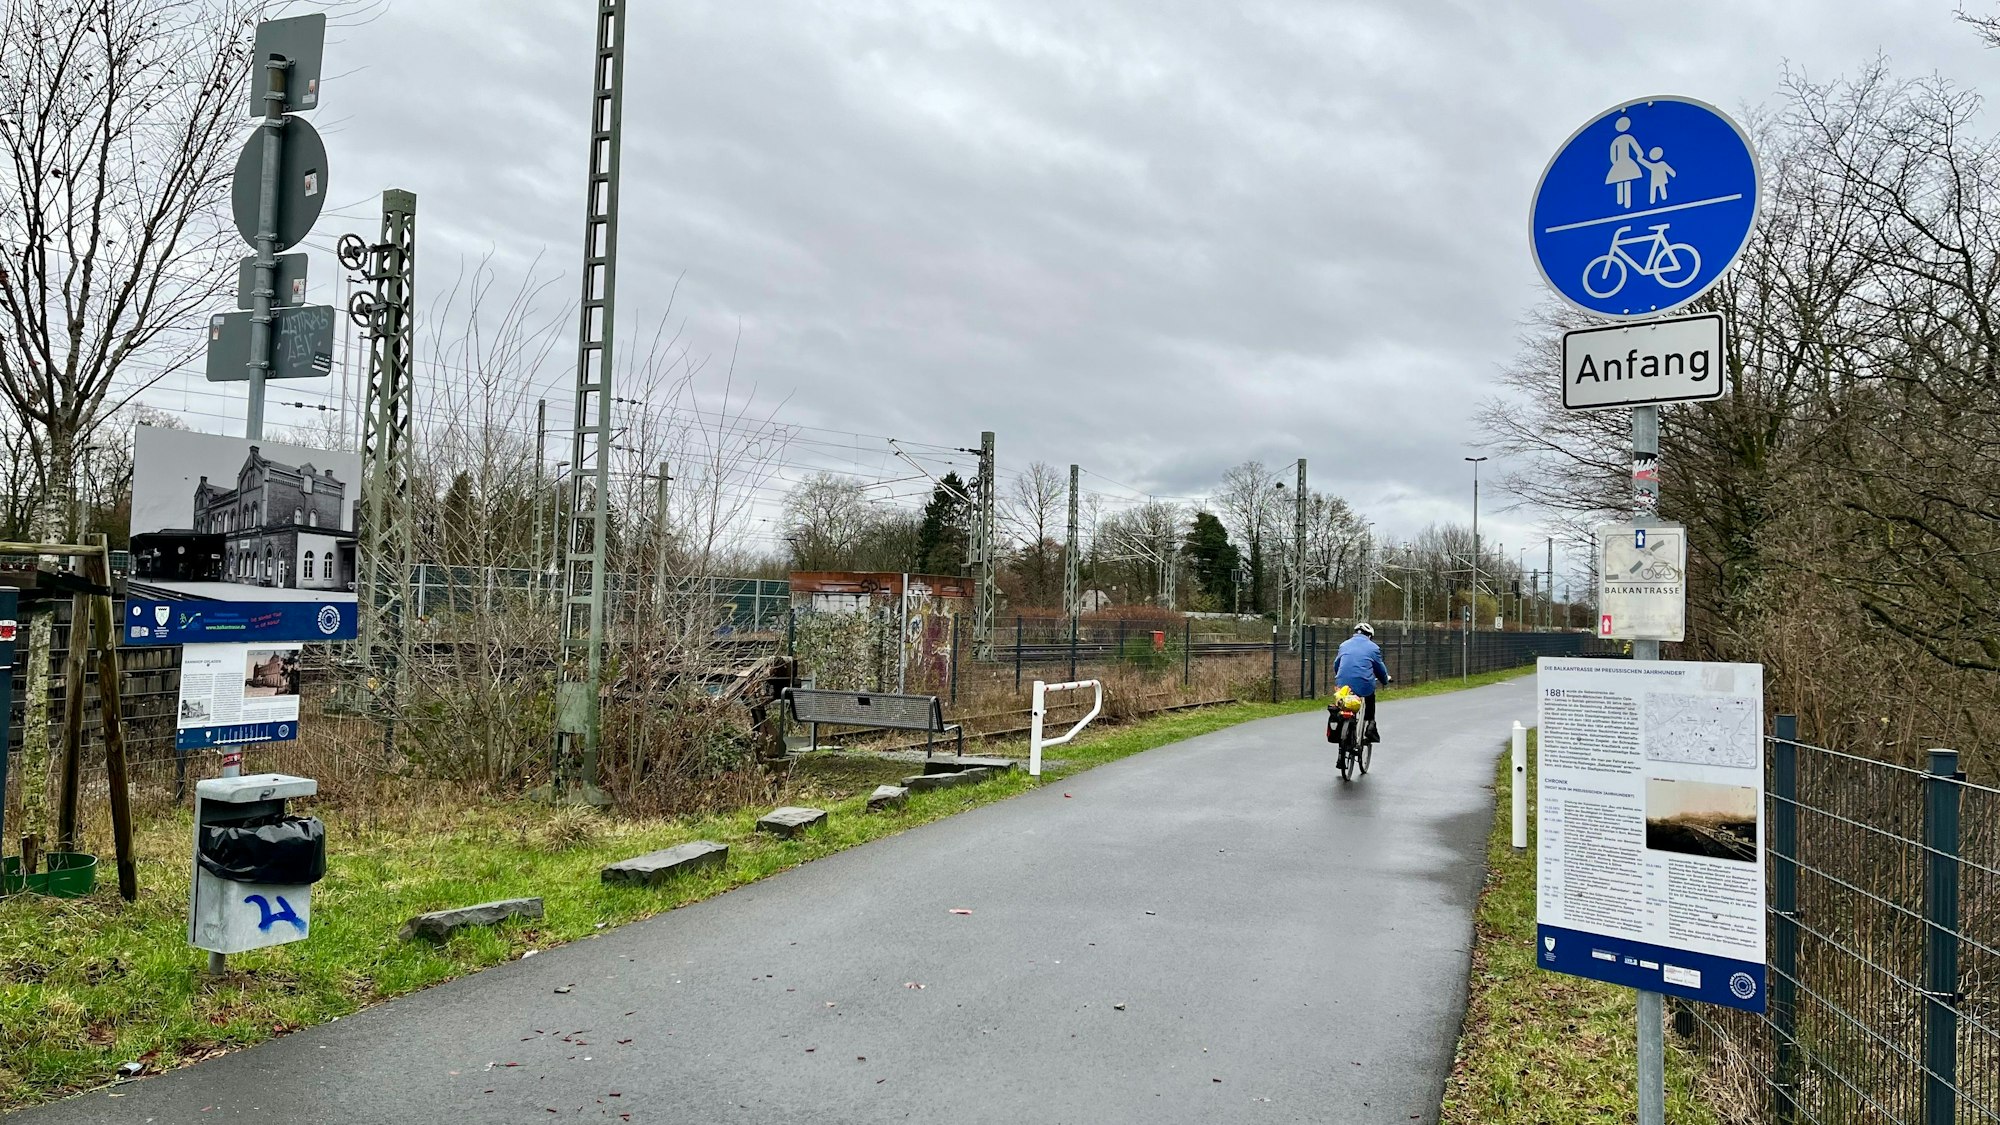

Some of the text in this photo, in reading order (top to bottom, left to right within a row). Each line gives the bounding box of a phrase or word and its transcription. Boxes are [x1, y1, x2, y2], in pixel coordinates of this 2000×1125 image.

[1575, 349, 1709, 384] Anfang
[1604, 586, 1680, 594] BALKANTRASSE
[1545, 688, 1565, 697] 1881
